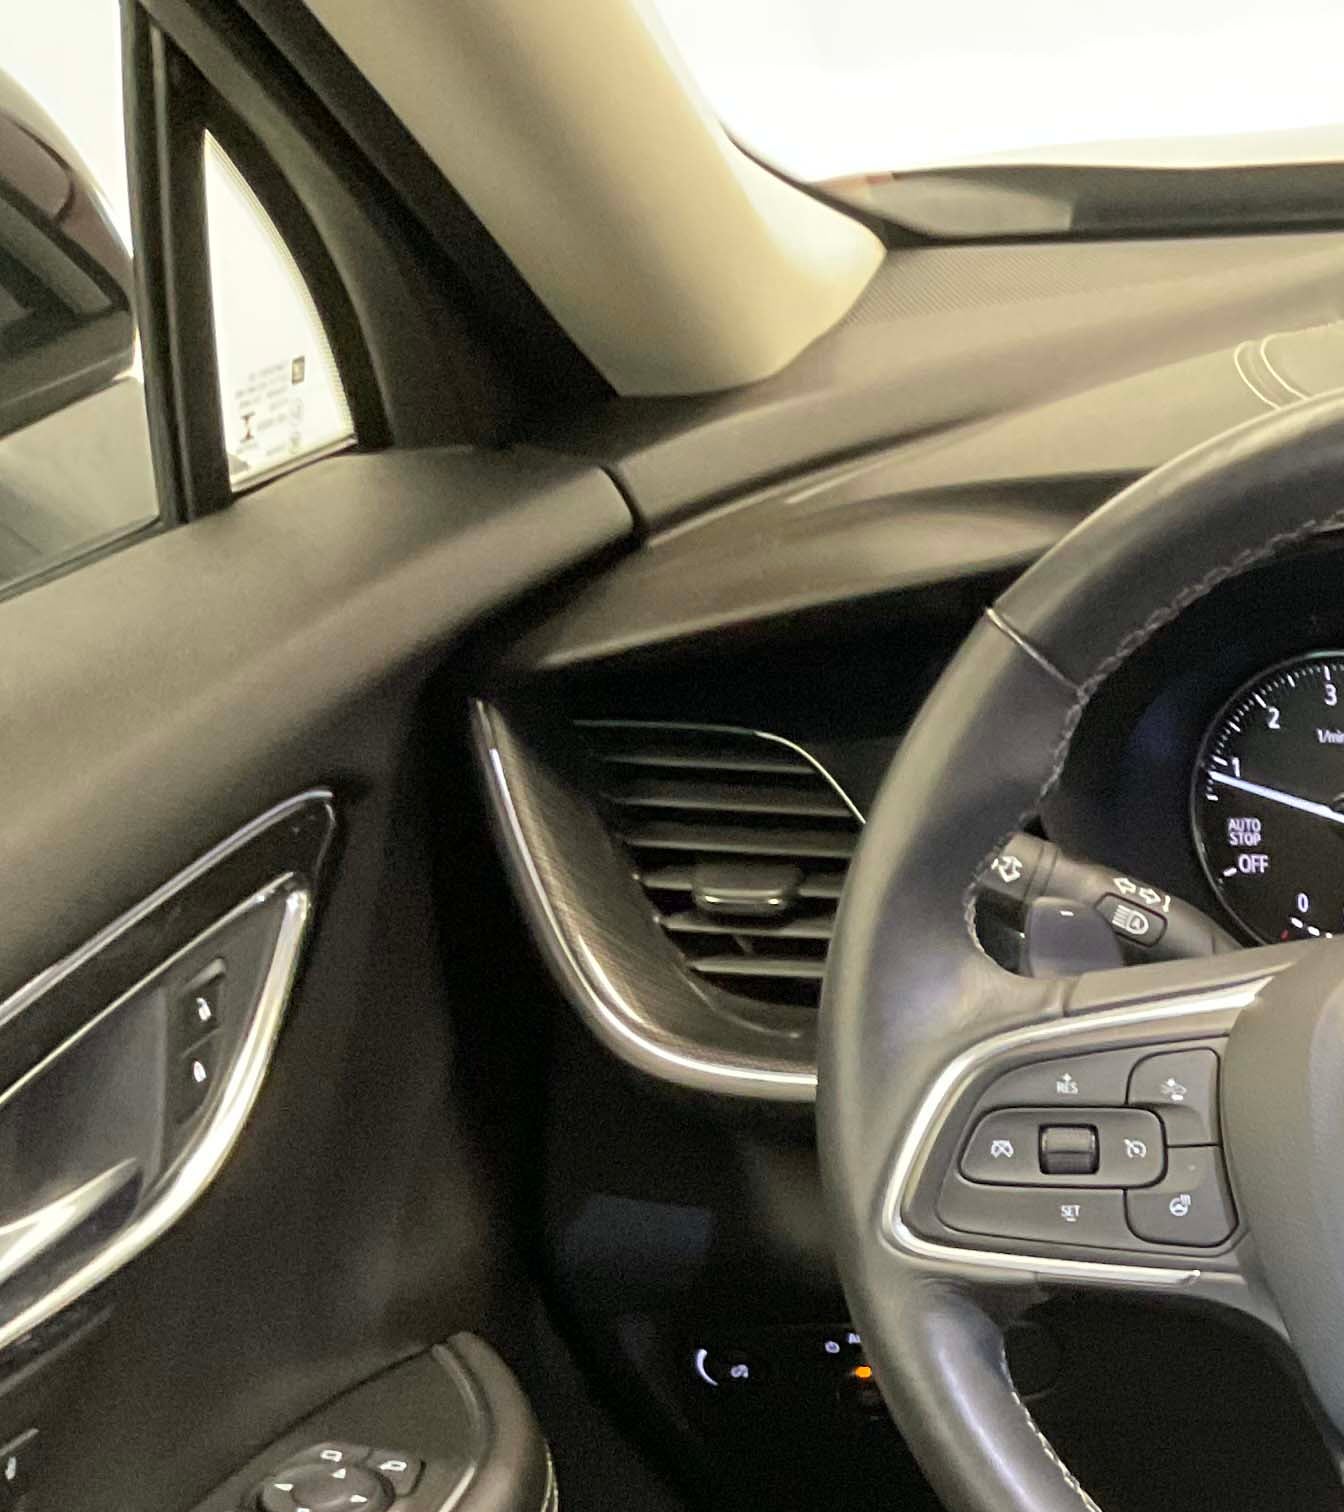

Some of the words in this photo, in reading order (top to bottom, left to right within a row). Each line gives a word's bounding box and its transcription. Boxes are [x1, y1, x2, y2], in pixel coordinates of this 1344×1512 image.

[1324, 684, 1338, 706] 3
[1267, 707, 1281, 729] 2
[1227, 818, 1261, 833] AUTO
[1228, 832, 1261, 847] STOP
[1238, 854, 1269, 874] OFF
